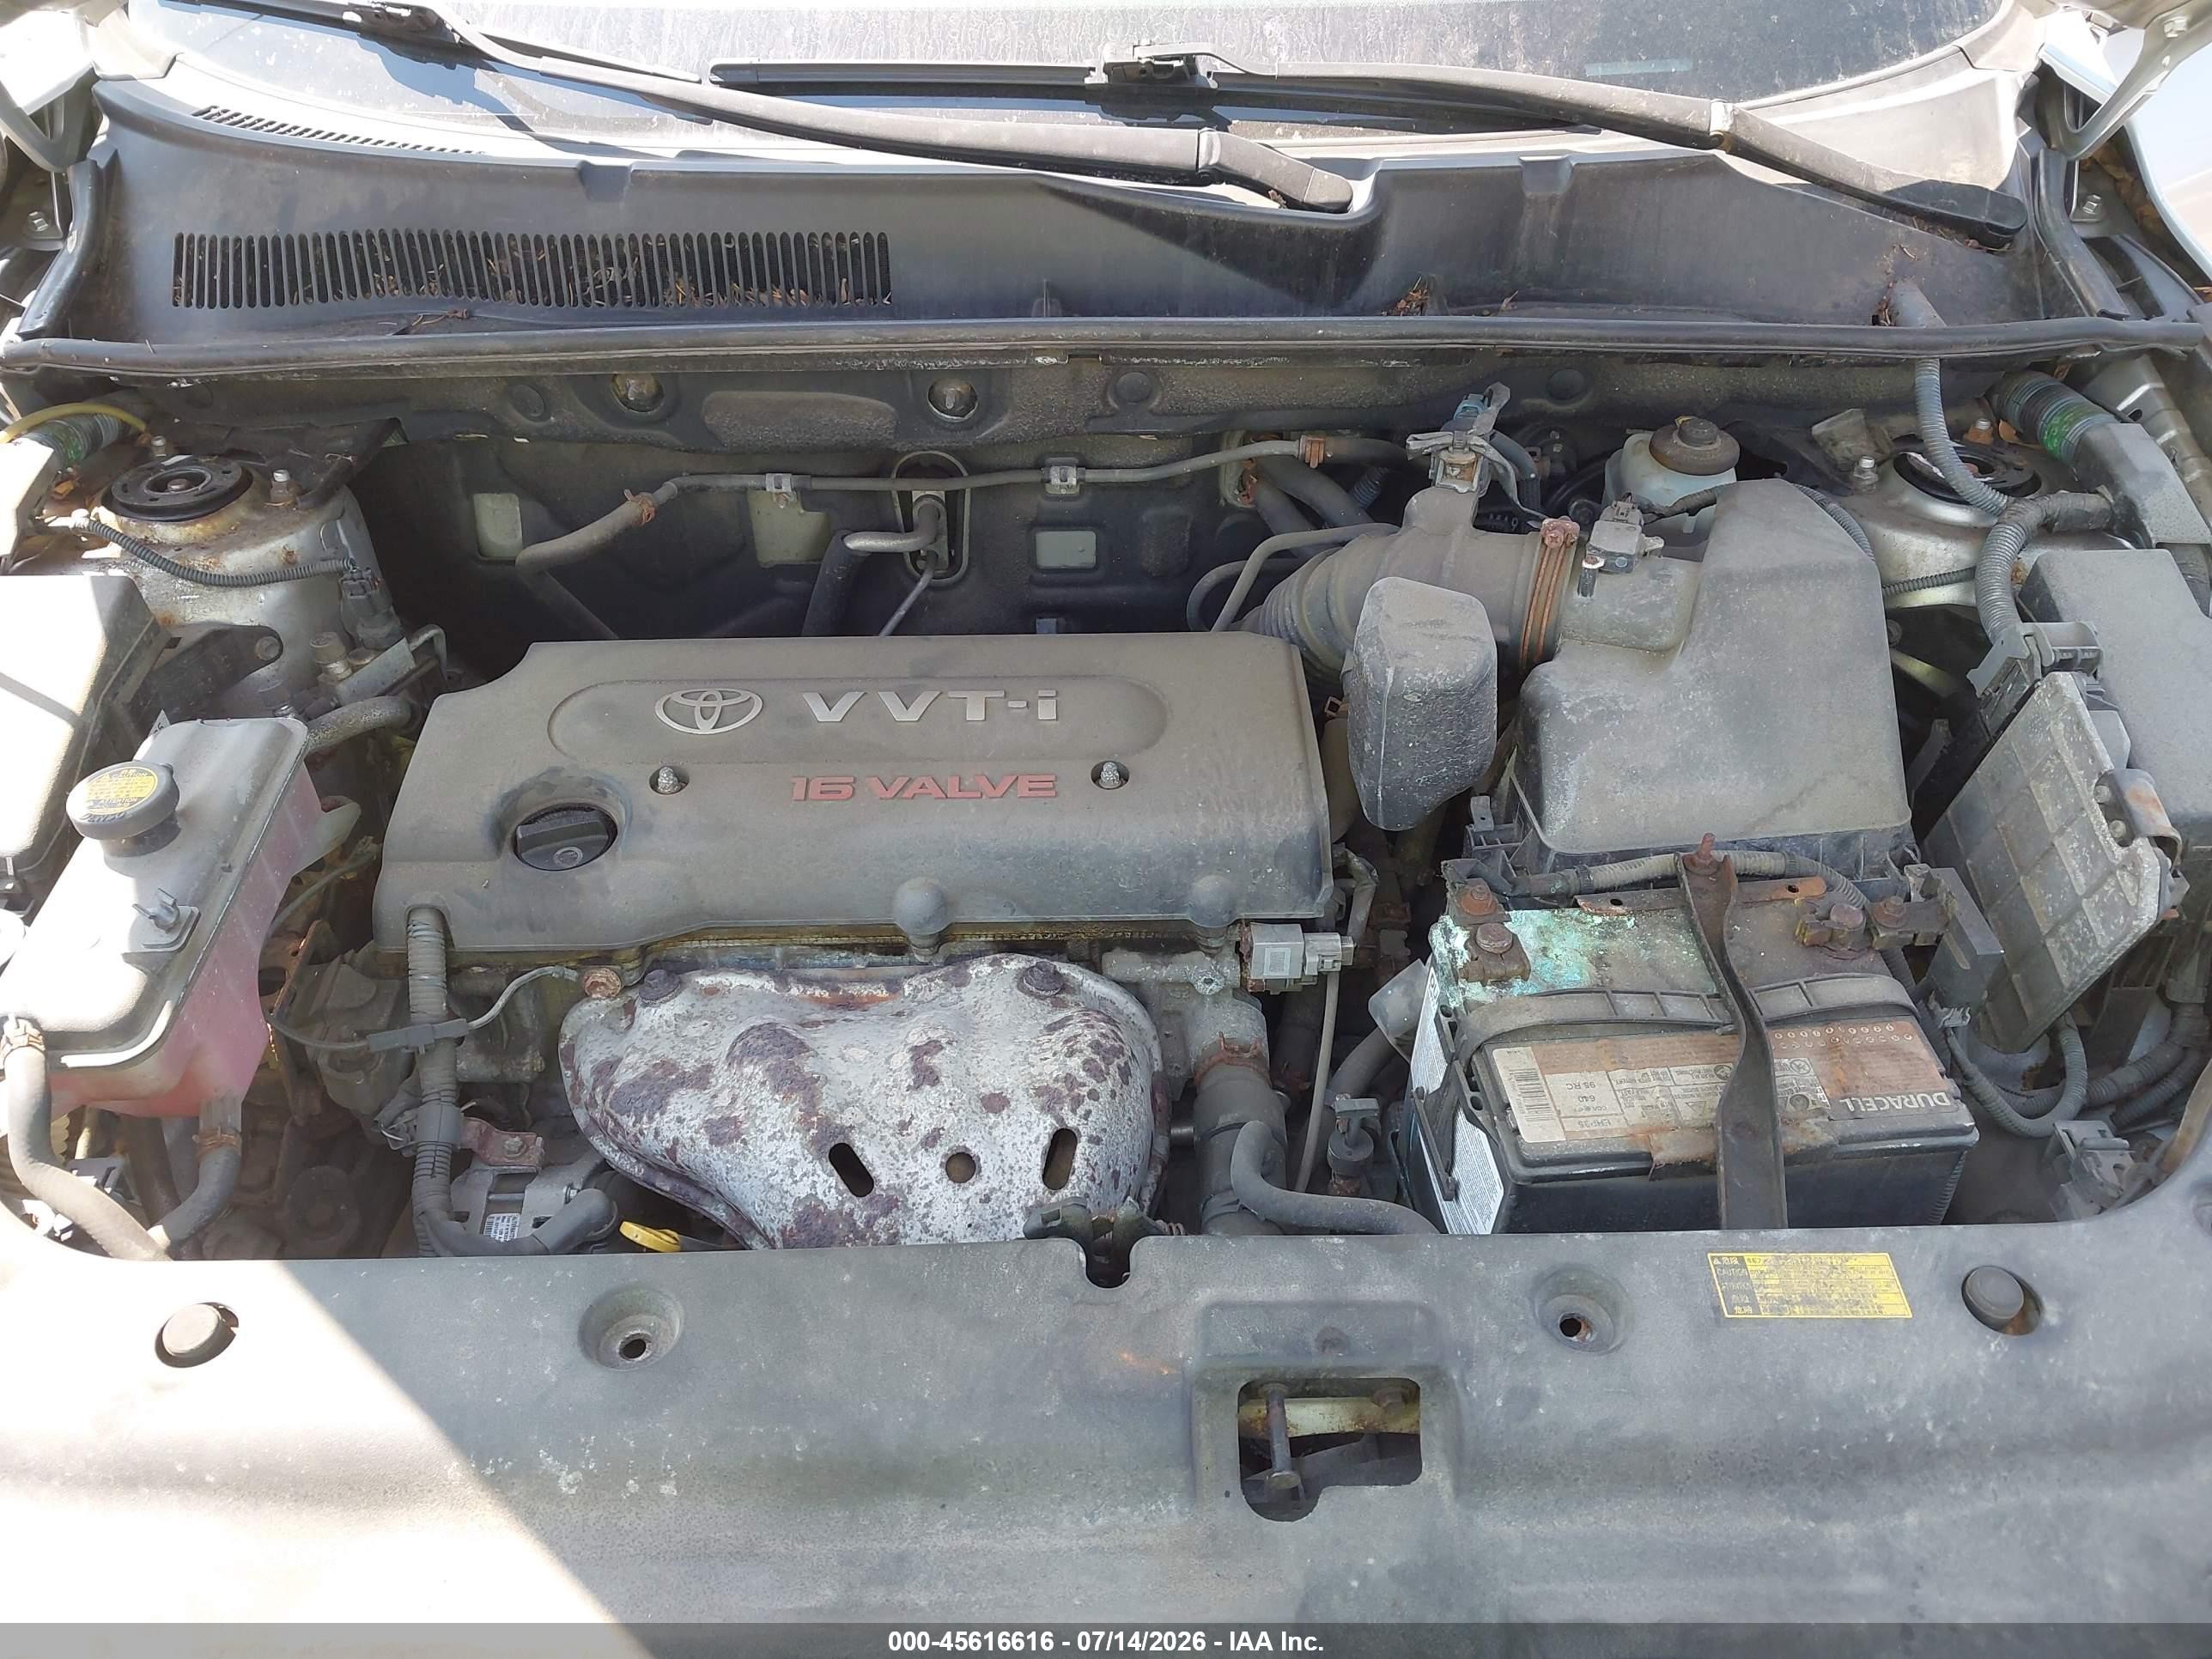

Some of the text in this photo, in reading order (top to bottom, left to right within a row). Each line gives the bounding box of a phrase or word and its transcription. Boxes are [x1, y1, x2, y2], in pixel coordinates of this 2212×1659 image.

[802, 690, 1058, 722] VVT-i
[790, 775, 1057, 800] 16 VALVE
[1565, 1081, 1582, 1091] RC
[1838, 1091, 1951, 1112] DURACELL
